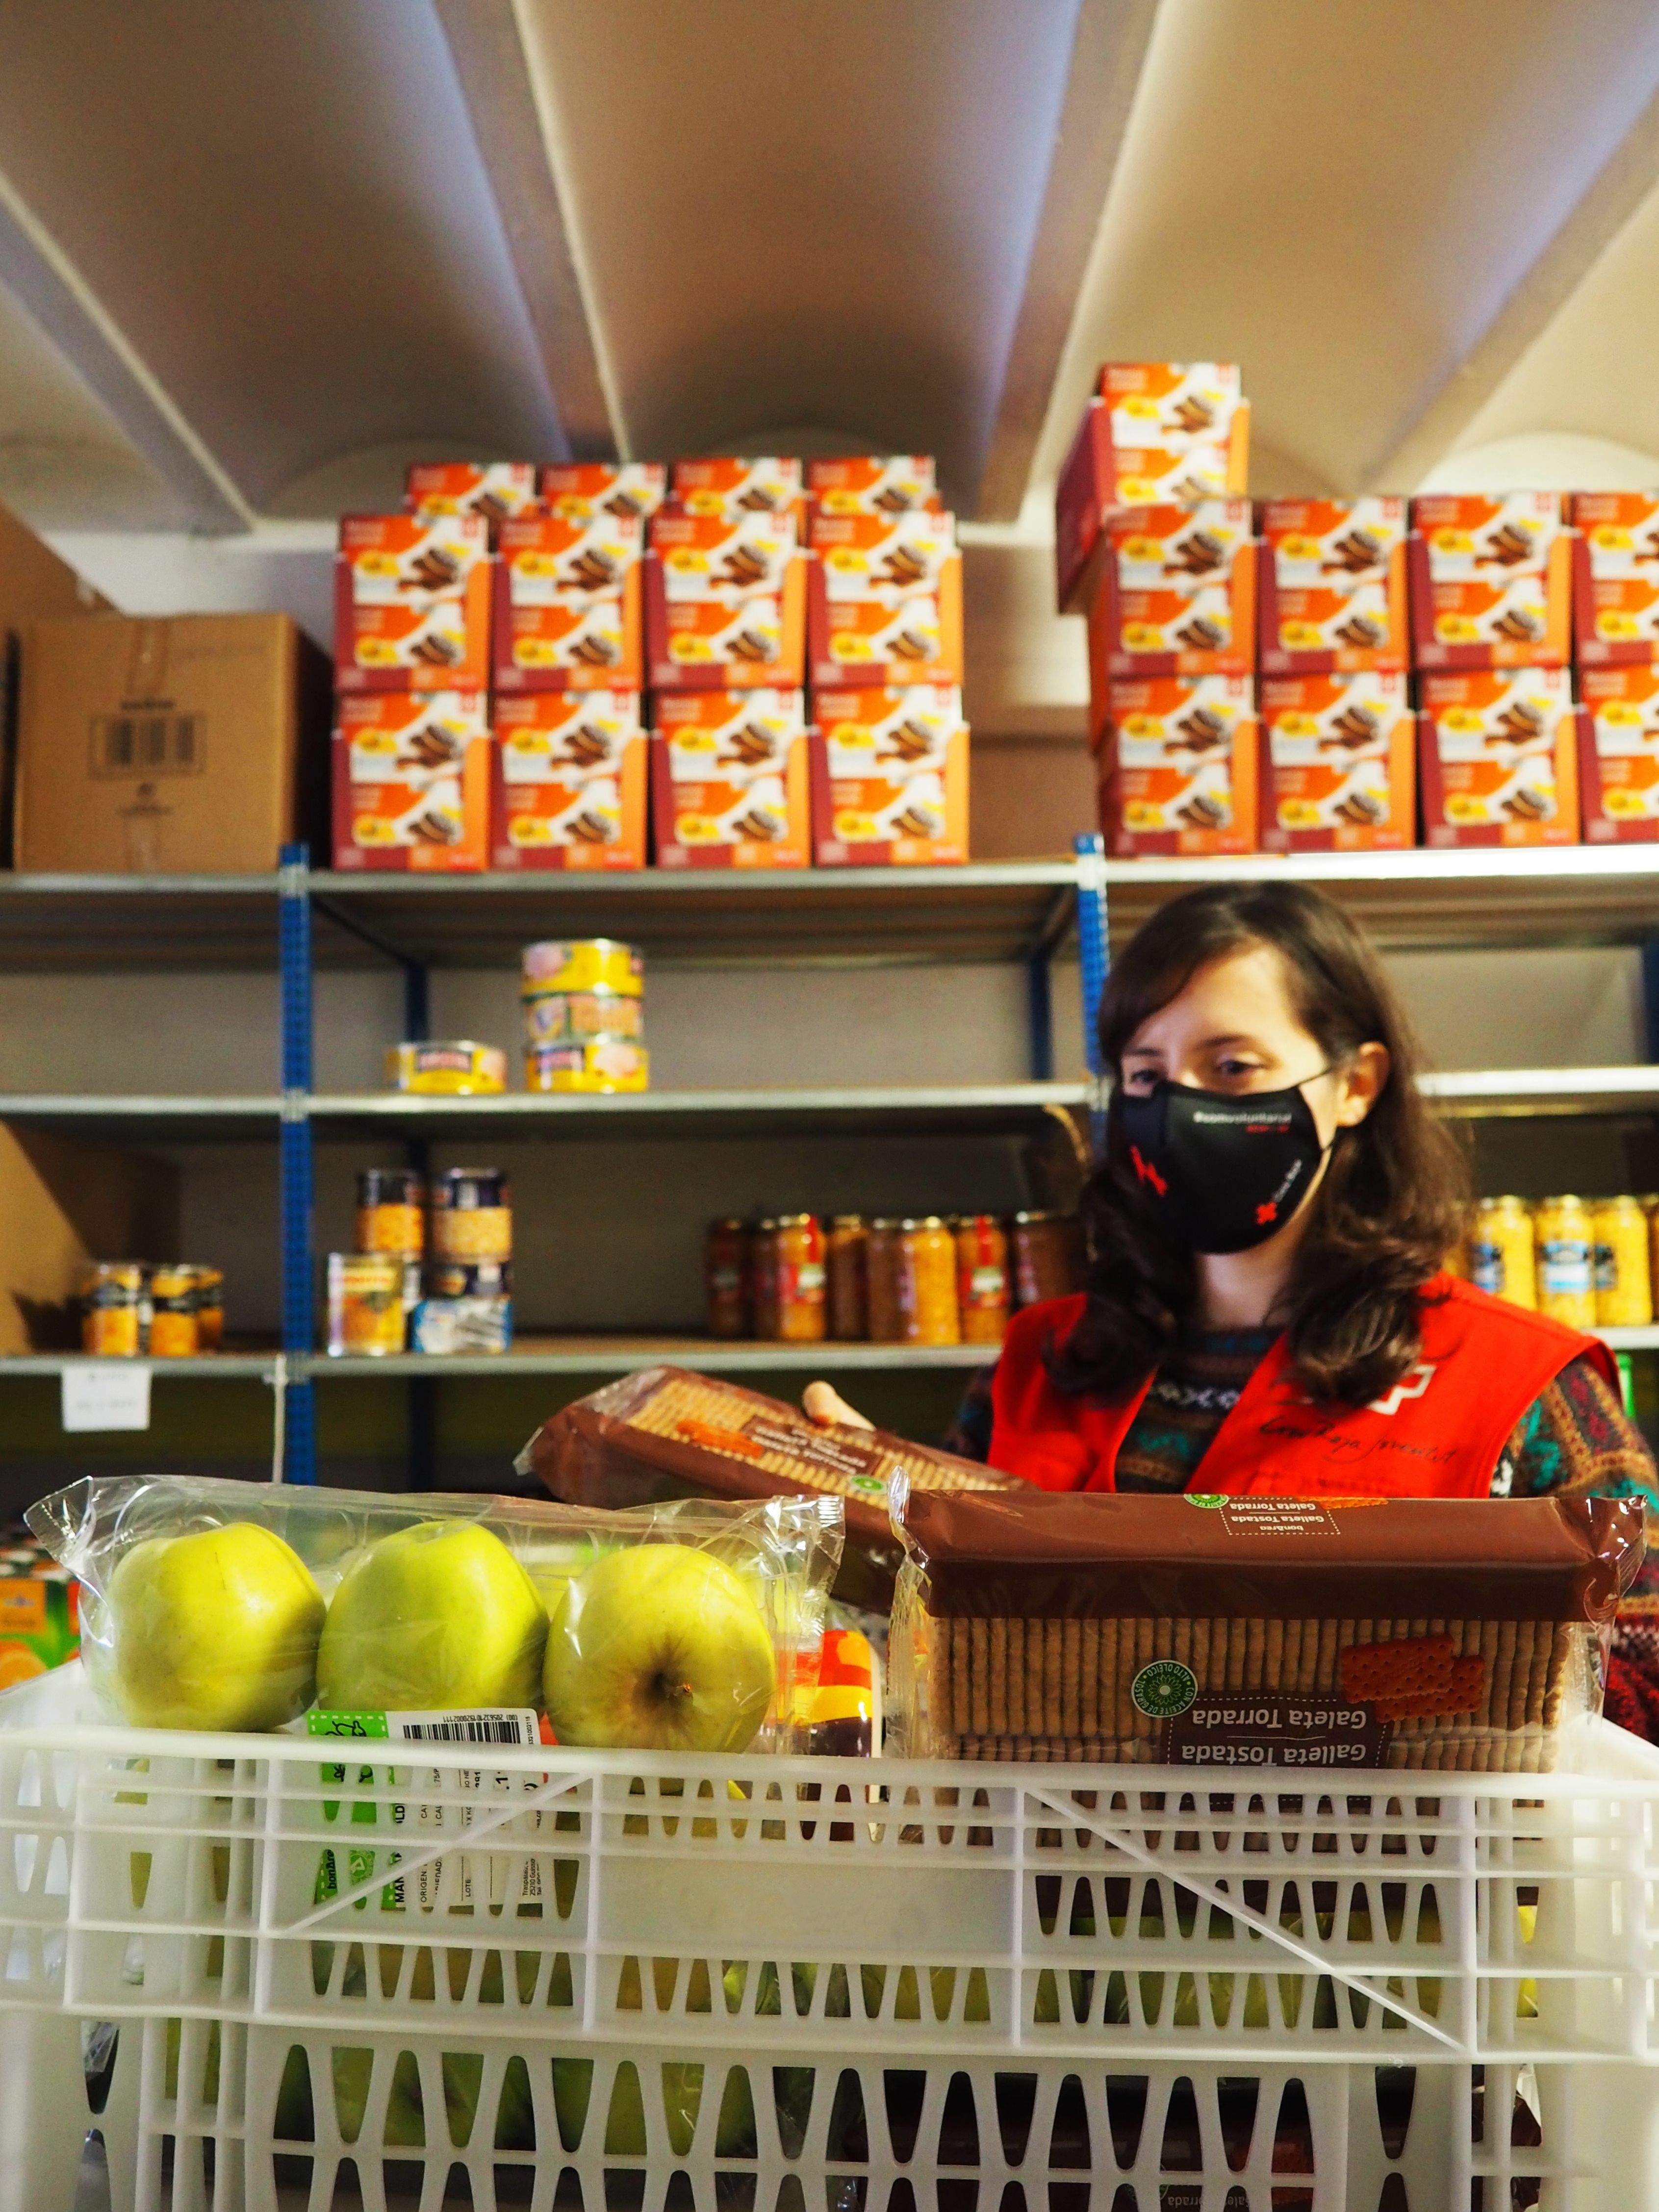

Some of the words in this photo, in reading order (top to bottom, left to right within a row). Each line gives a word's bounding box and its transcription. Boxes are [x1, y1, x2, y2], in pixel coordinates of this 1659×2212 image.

[1229, 1503, 1276, 1511] Torrada
[1174, 1666, 1191, 1681] ALTO
[1135, 1680, 1149, 1709] GIRASOL
[1182, 1687, 1195, 1702] CON
[1147, 1705, 1159, 1714] DE
[1159, 1701, 1186, 1715] ACEITE
[1192, 1708, 1282, 1729] Torrada
[1288, 1709, 1366, 1729] Galeta
[1181, 1745, 1277, 1766] Tostada
[1283, 1744, 1366, 1764] Galleta
